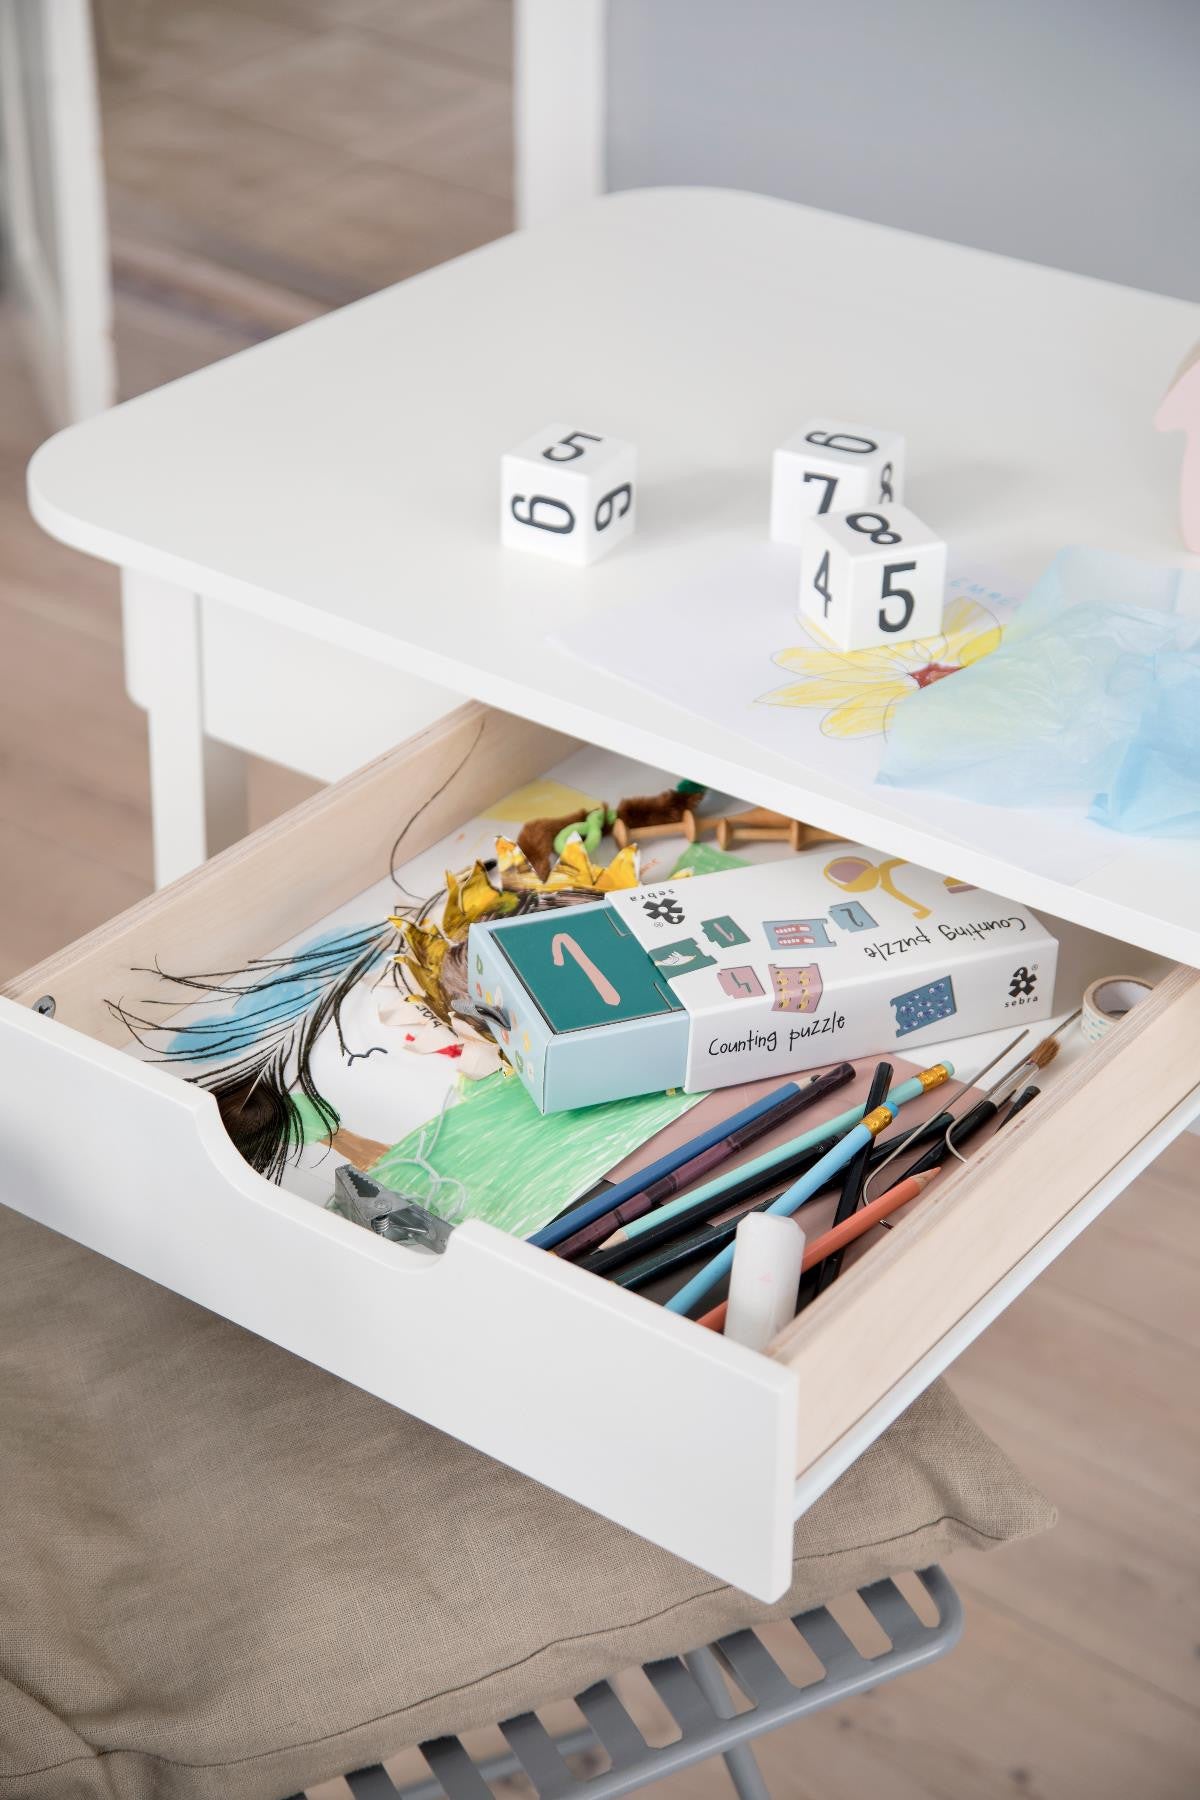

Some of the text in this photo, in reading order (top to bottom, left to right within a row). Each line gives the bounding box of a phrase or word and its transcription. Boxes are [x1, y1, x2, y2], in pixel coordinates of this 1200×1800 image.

[541, 431, 602, 462] 5
[803, 470, 839, 515] 7
[845, 511, 903, 545] 8
[813, 549, 833, 618] 4
[877, 560, 917, 633] 5
[629, 888, 675, 902] sebra
[863, 917, 1027, 961] Counting puzzle
[1003, 995, 1039, 1008] sebra
[708, 1010, 846, 1056] Counting puzzle
